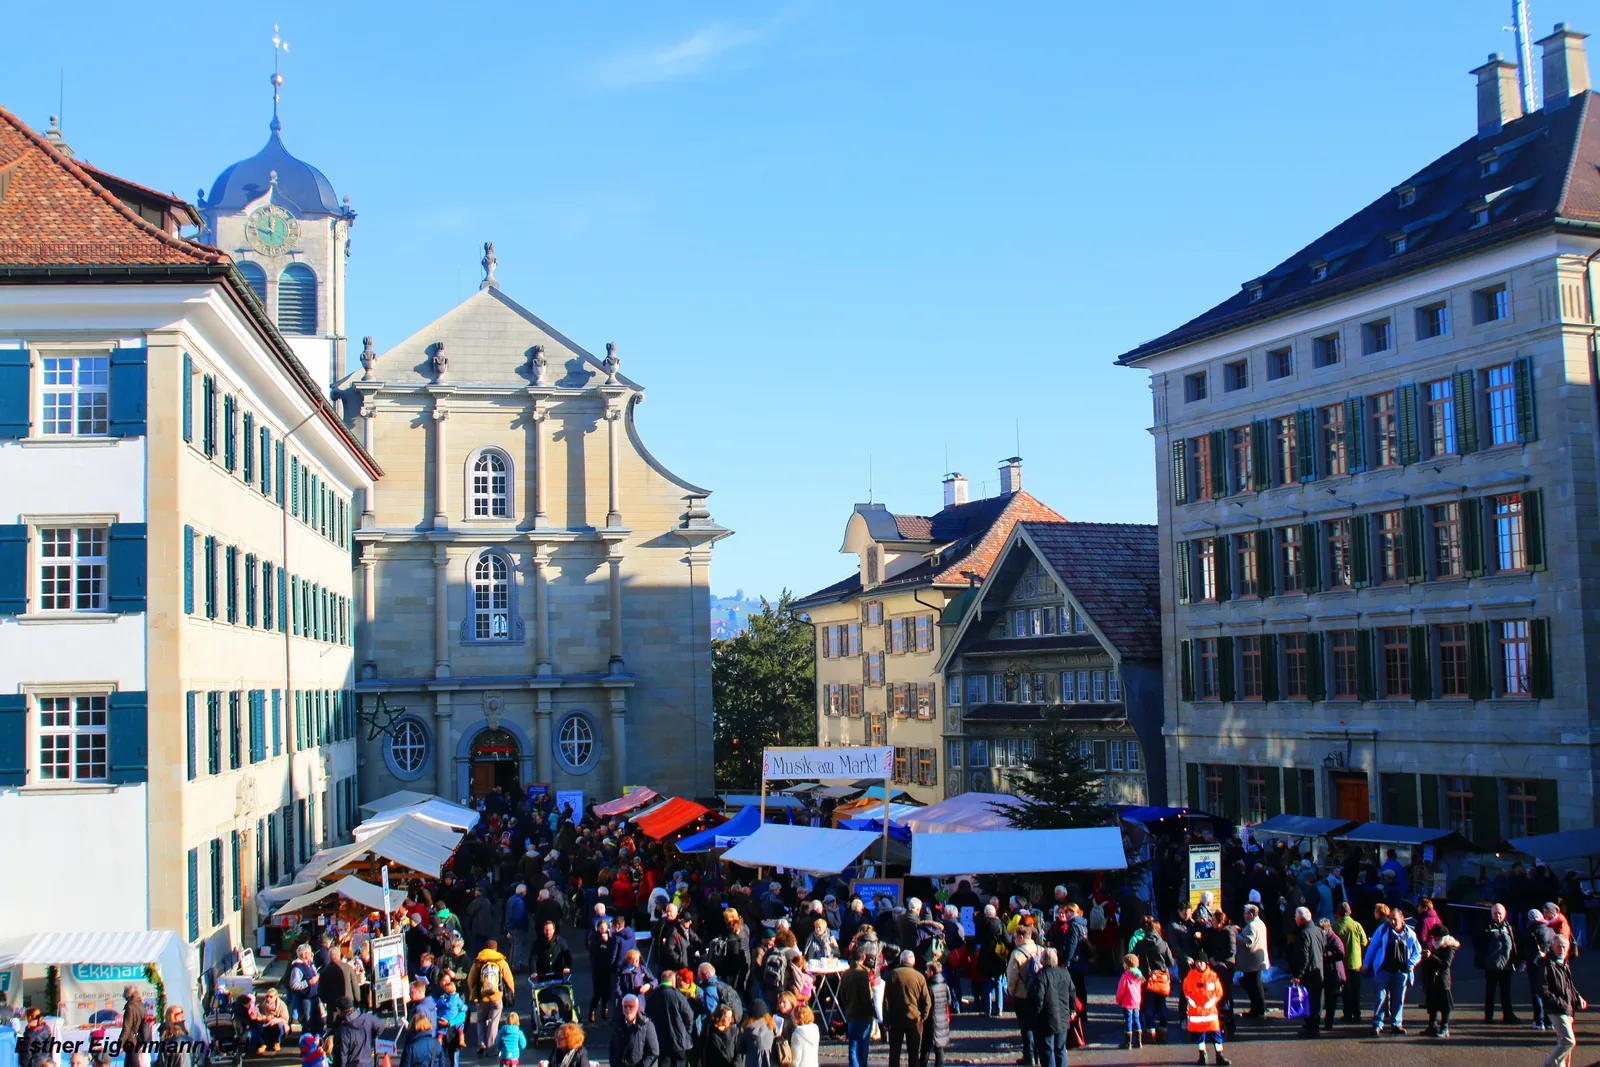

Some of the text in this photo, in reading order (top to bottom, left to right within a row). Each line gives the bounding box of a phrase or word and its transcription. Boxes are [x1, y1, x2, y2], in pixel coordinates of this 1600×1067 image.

[772, 753, 880, 775] Musik am Markt
[75, 992, 97, 1000] Leben
